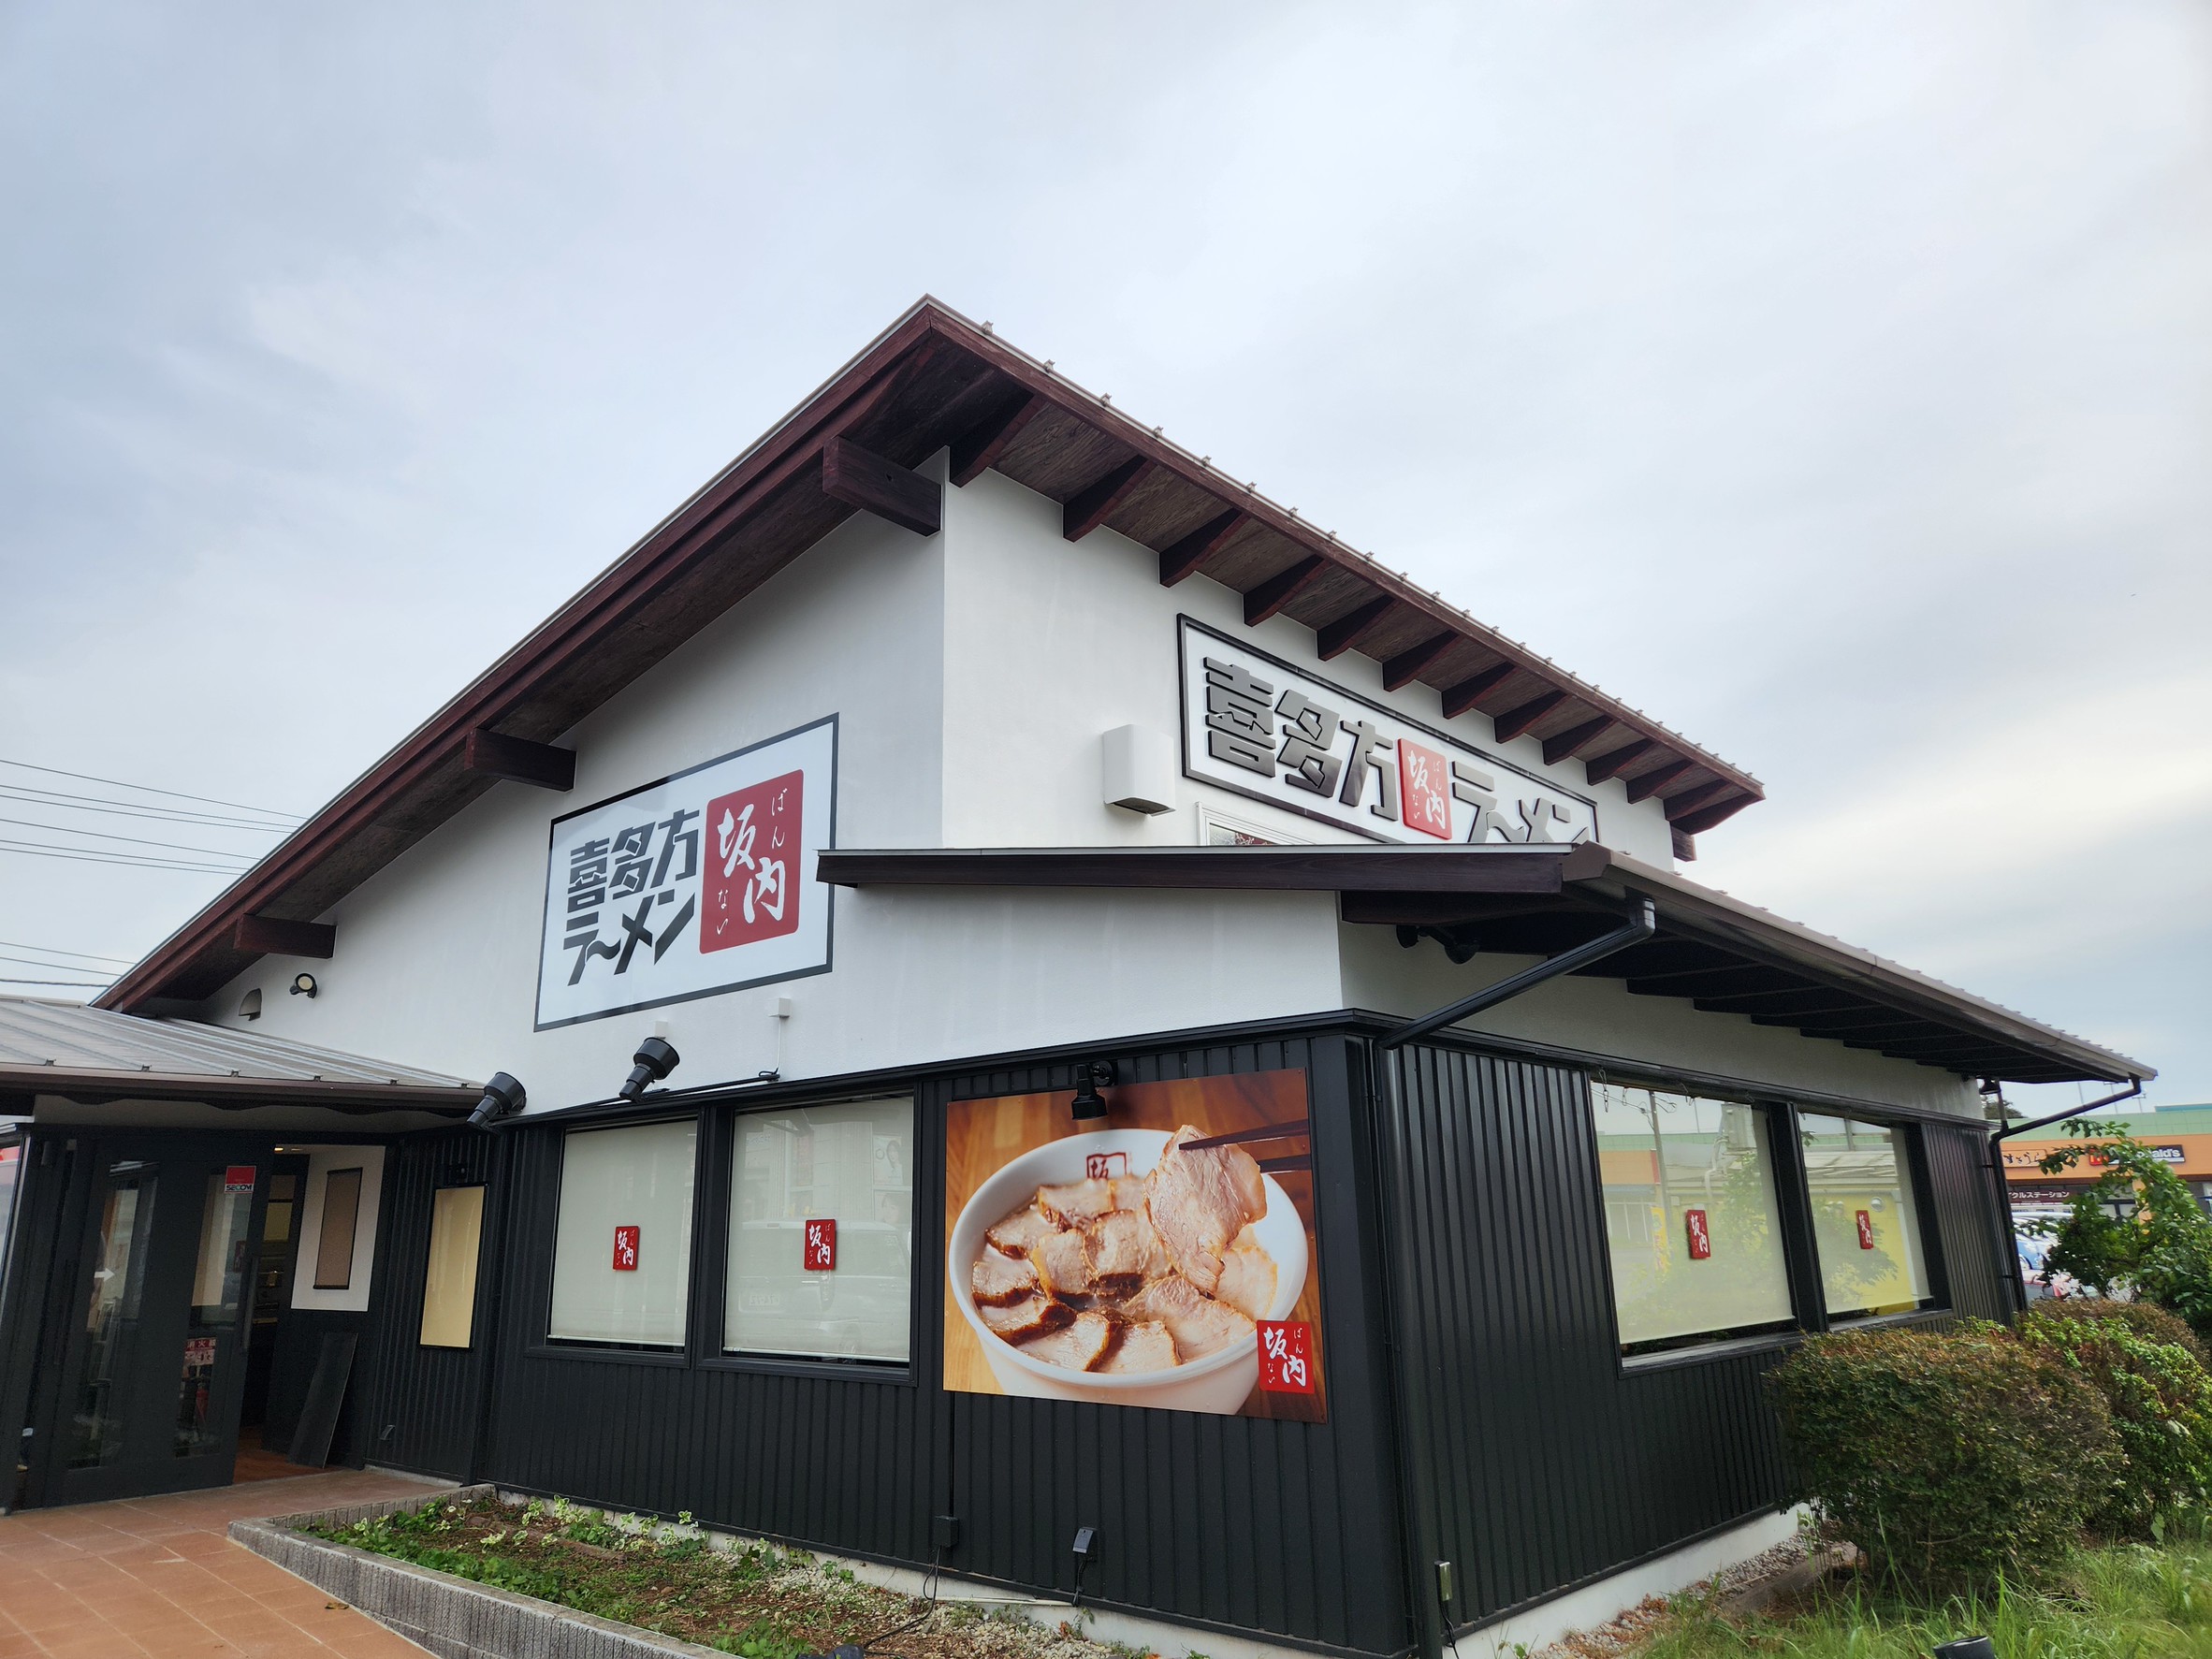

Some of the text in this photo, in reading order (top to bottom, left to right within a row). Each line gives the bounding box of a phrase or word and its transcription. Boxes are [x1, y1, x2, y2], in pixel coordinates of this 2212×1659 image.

[1203, 656, 1398, 821] 喜多方
[772, 788, 788, 849] ばん
[1407, 749, 1446, 830] 坂内
[567, 808, 700, 913] 喜多方
[717, 804, 786, 924] 坂内
[562, 888, 696, 986] ラーメン
[716, 889, 729, 935] ない
[618, 1230, 634, 1266] 坂内
[808, 1224, 831, 1265] 坂内
[1263, 1326, 1306, 1387] 坂内
[1293, 1327, 1303, 1354] ばん
